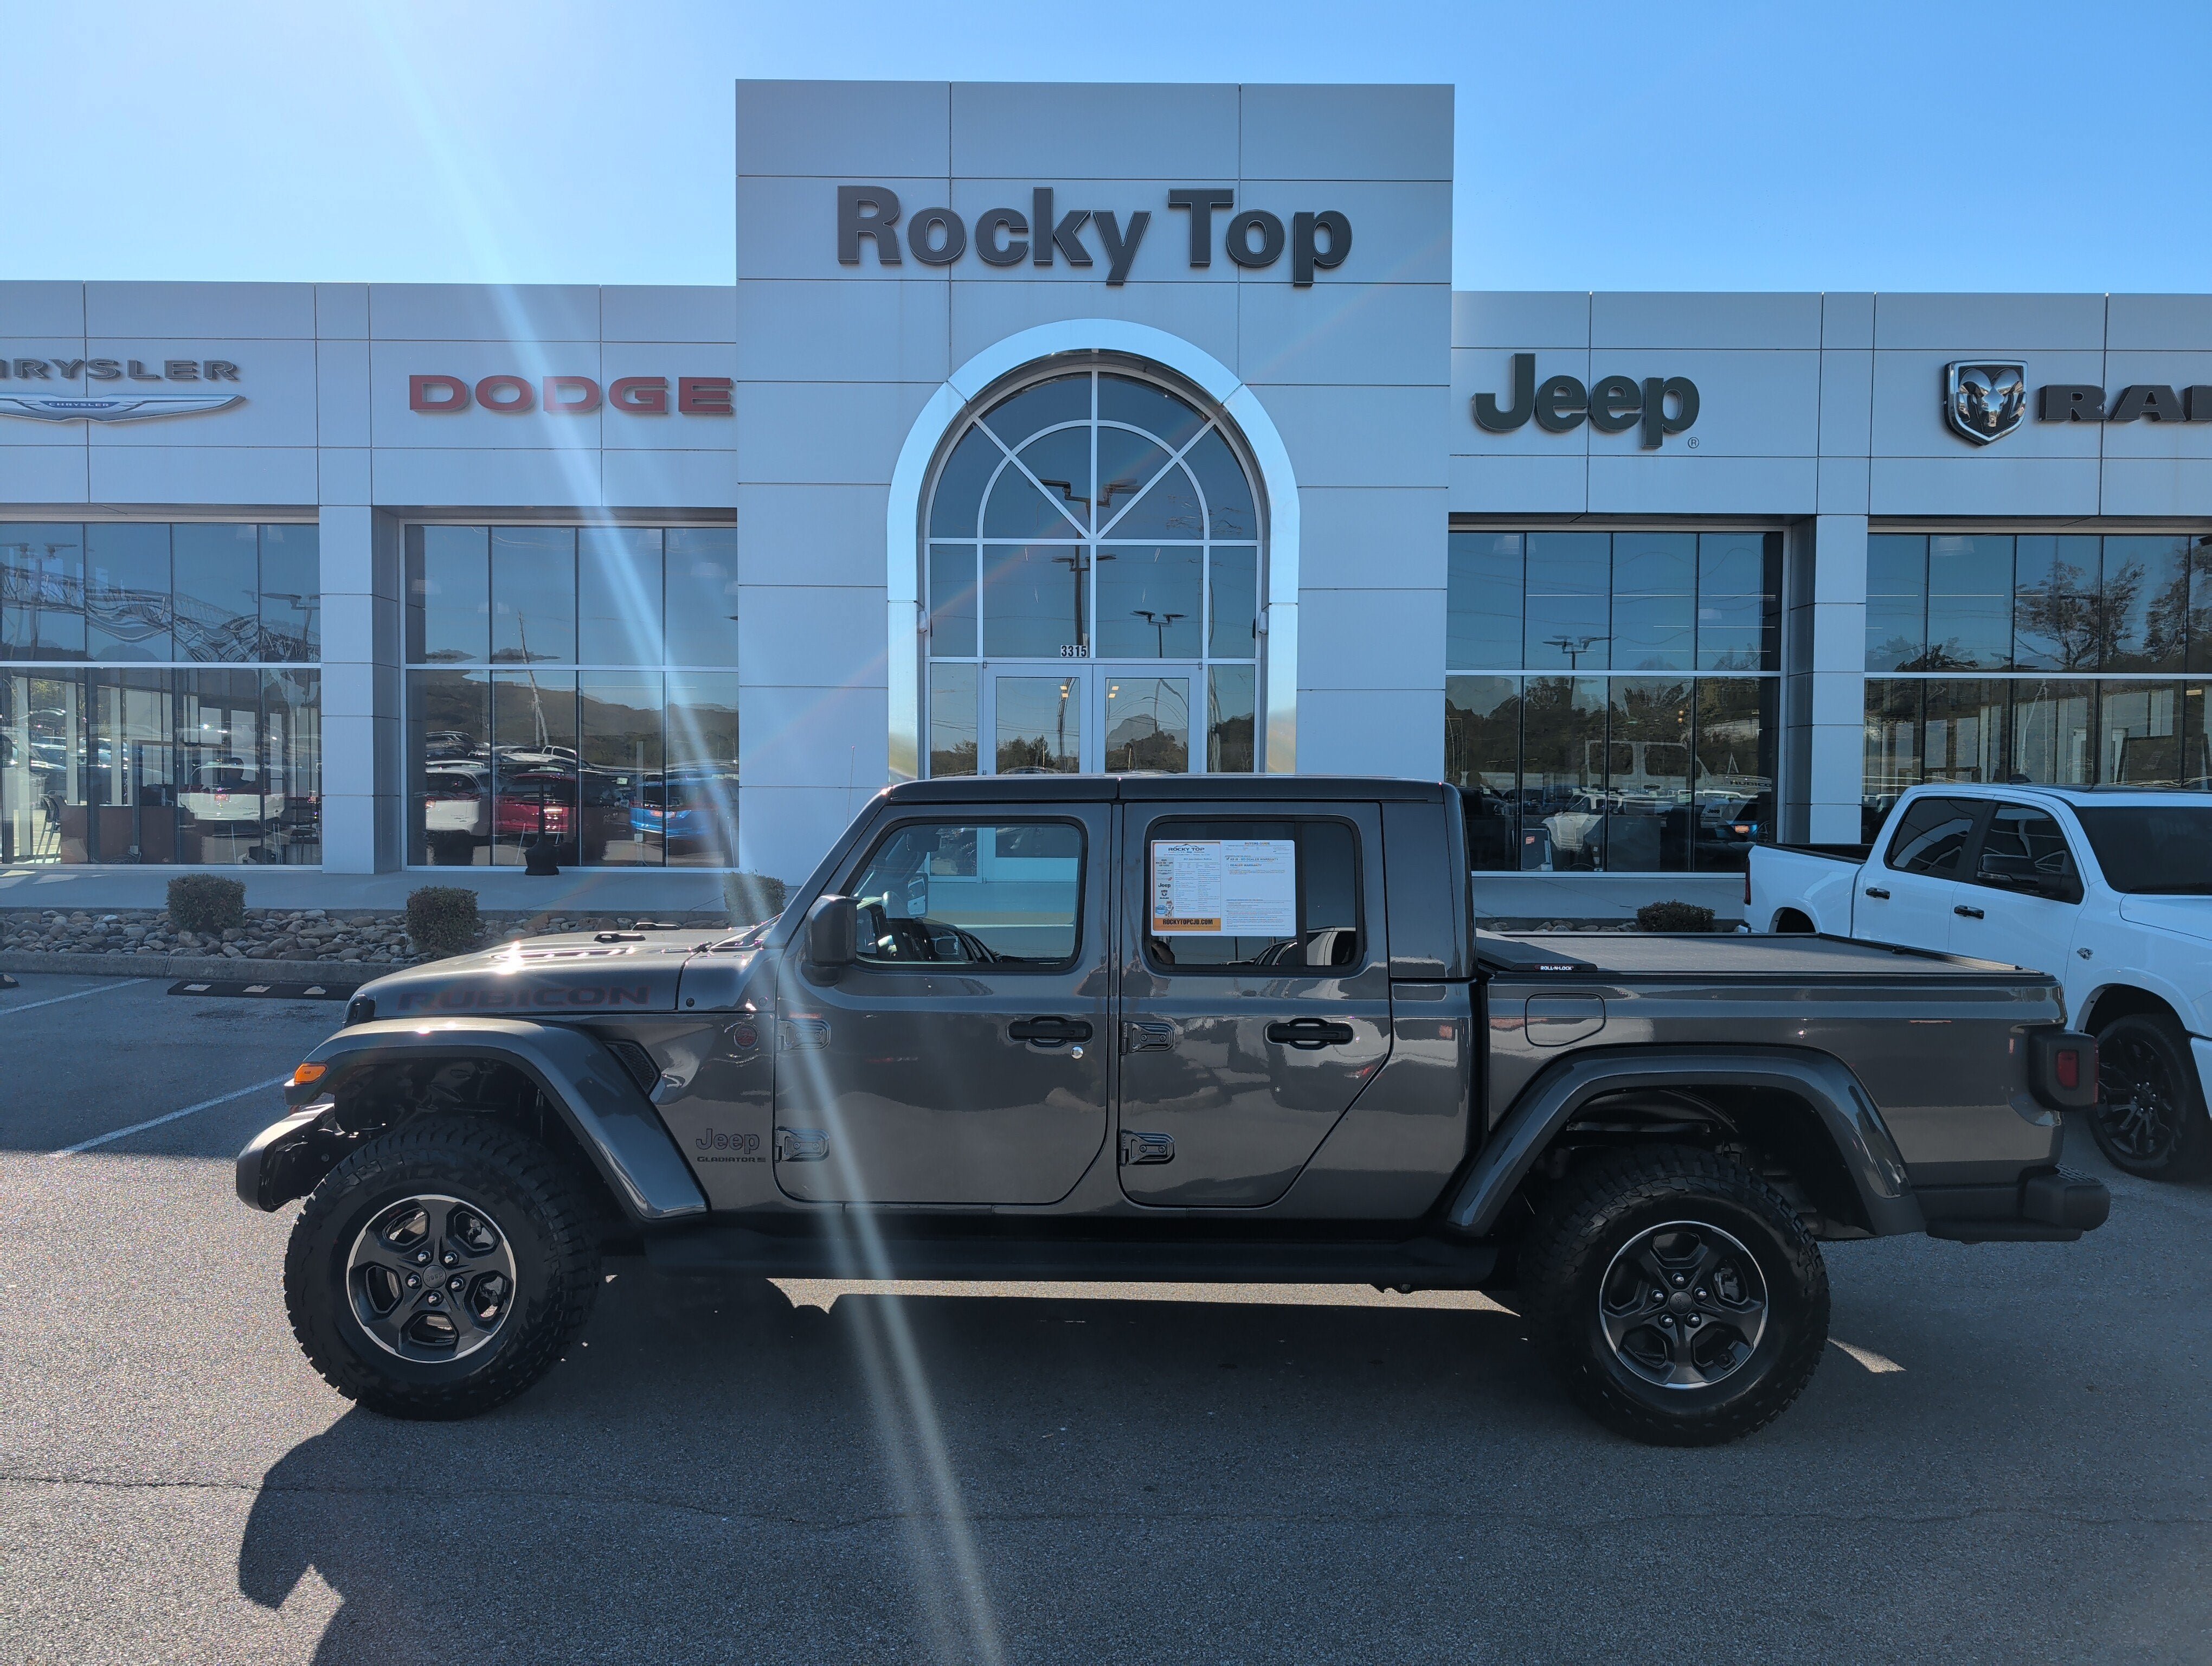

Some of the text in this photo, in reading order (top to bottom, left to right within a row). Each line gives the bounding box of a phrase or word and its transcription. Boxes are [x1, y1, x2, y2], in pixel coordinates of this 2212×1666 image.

[837, 185, 1353, 287] Rocky Top
[0, 358, 239, 380] RYSLER
[409, 375, 733, 416] DODGE
[1472, 353, 1700, 449] Jeep
[1061, 645, 1086, 657] 3315
[397, 985, 650, 1011] RUBICON
[696, 1128, 760, 1154] Jeep
